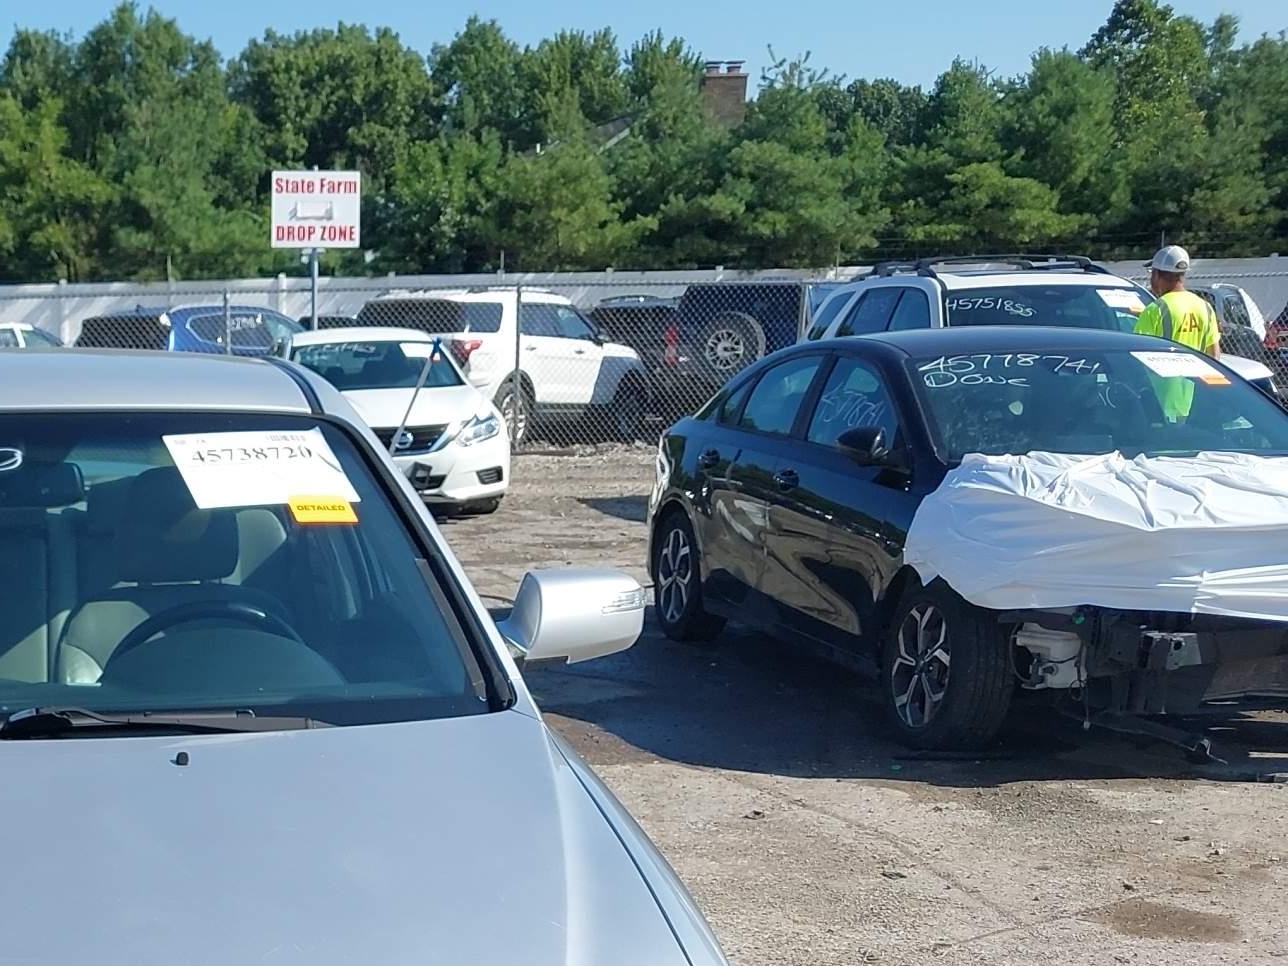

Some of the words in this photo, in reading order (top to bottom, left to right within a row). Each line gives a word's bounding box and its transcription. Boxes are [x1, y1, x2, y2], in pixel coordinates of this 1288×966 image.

[275, 177, 315, 194] State
[319, 177, 357, 194] Farm
[276, 225, 315, 241] DROP
[320, 225, 356, 241] ZONE
[192, 446, 313, 462] 45738720
